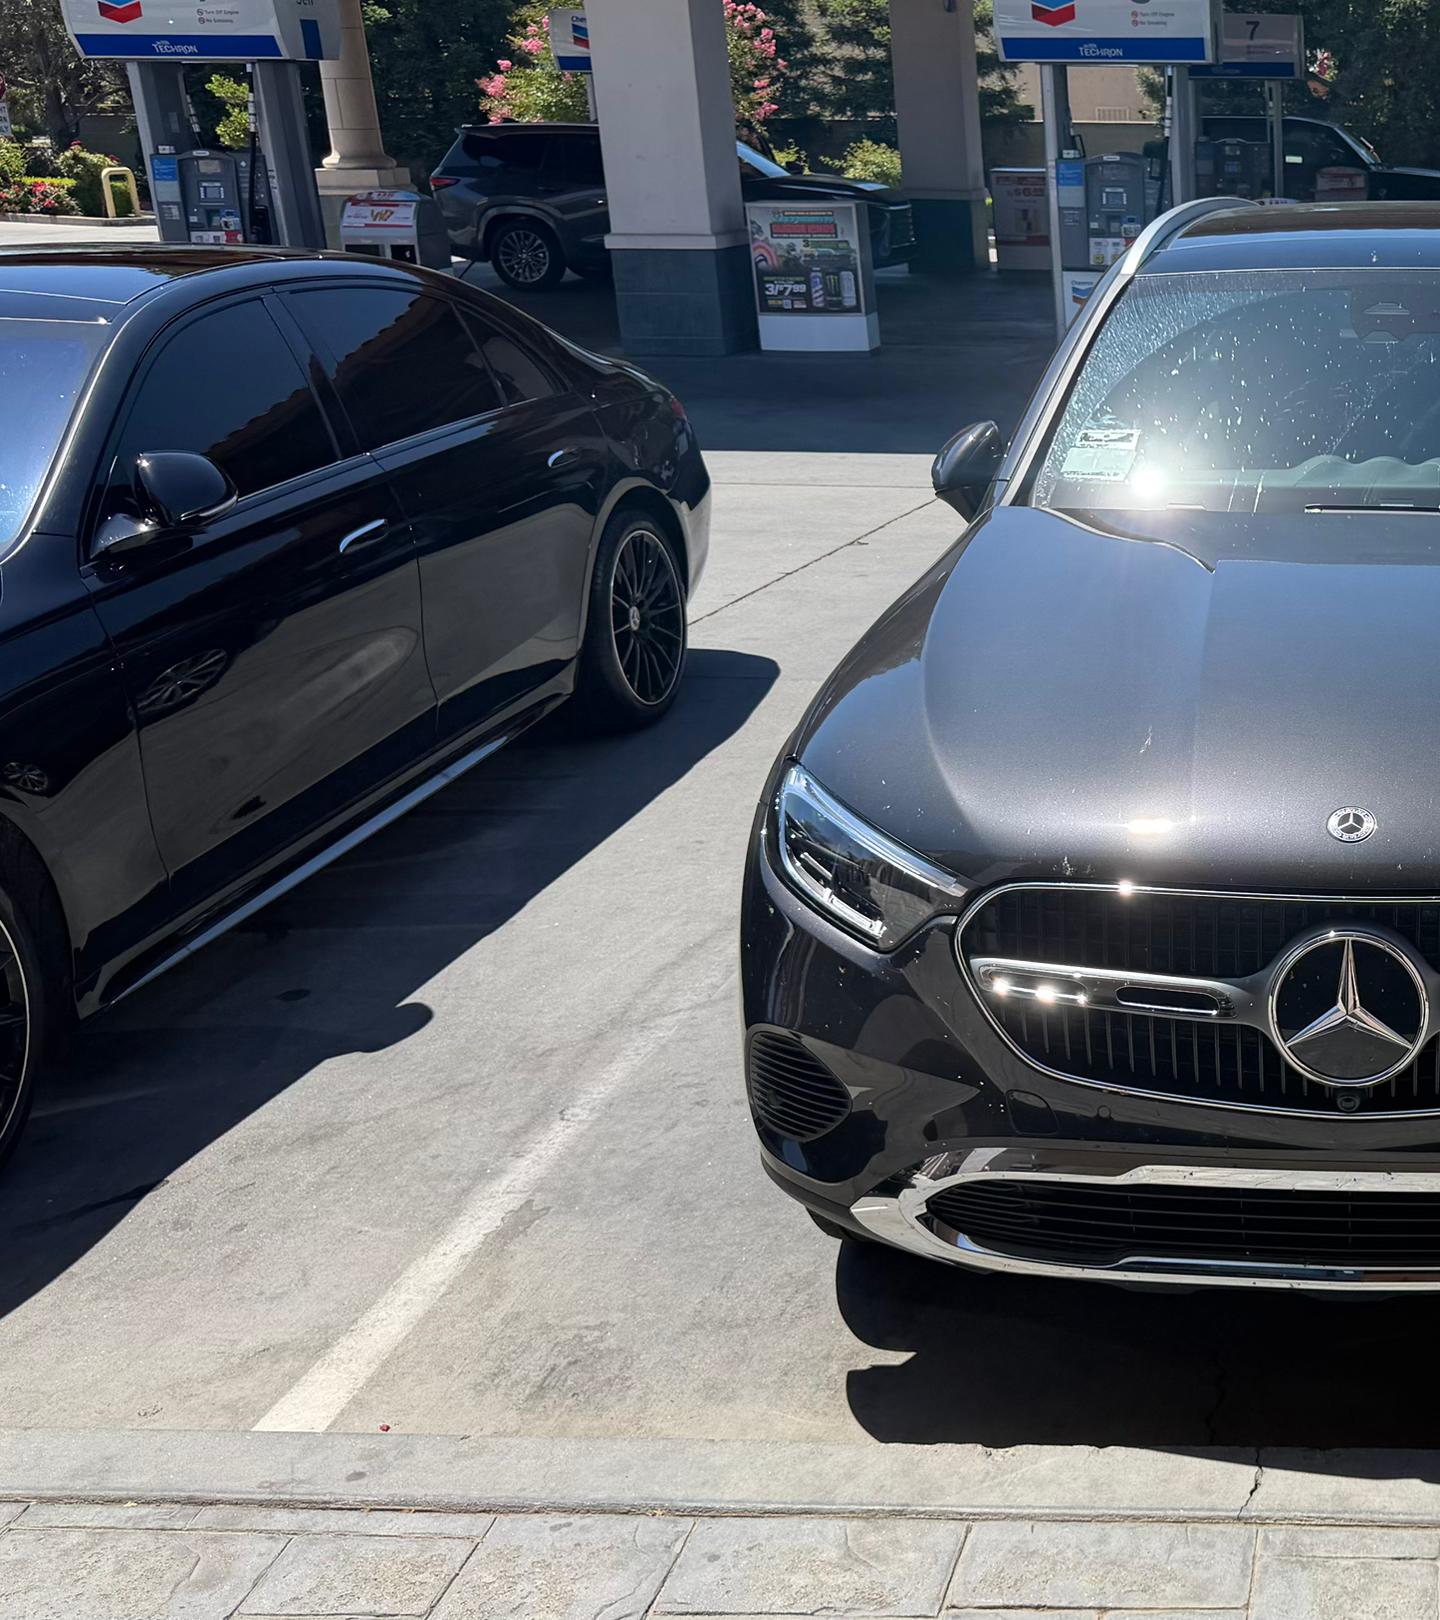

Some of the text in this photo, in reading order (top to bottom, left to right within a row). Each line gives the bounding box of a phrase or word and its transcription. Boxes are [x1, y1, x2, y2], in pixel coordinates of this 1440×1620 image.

[1245, 21, 1260, 41] 7
[151, 43, 199, 54] TECHRON
[1078, 46, 1123, 57] TECHRON
